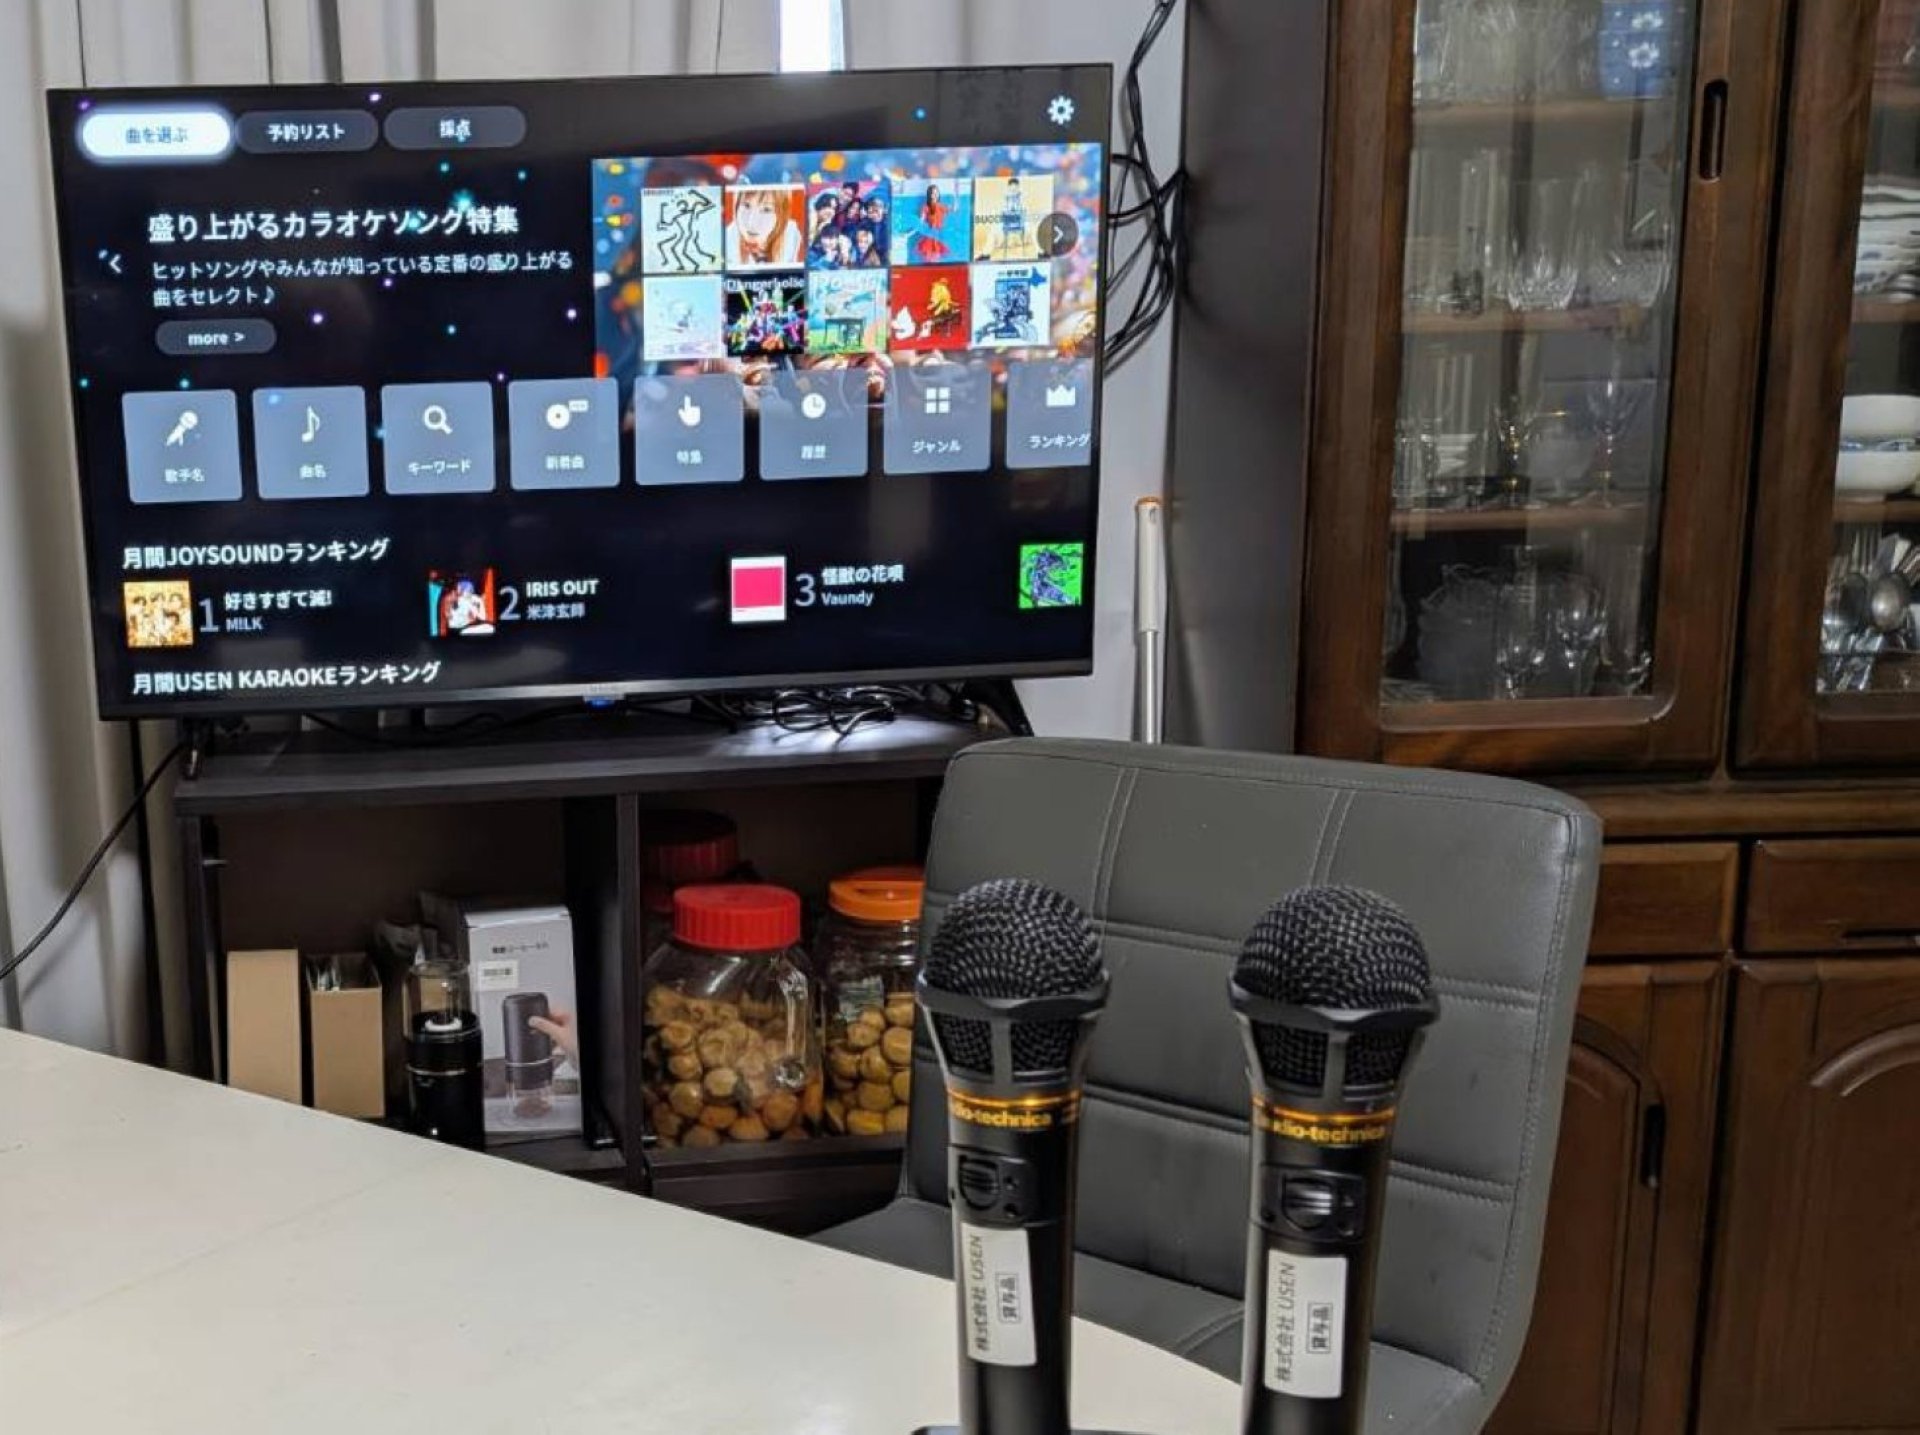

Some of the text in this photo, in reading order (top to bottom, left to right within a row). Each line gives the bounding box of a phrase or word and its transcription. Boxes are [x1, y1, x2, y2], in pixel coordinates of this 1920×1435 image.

[126, 125, 188, 144] 曲を選ぶ
[267, 122, 345, 142] 予約リスト
[149, 205, 519, 242] 盛り上がるカラオケソング特集
[153, 251, 573, 281] ヒットソングやみんなが知っている定番の盛り上がる
[188, 332, 228, 346] more
[912, 439, 961, 454] ジャンル
[1029, 433, 1091, 449] ランキング
[408, 458, 471, 475] キーワード
[122, 537, 390, 570] 月間JOYSOUNDランキング
[499, 585, 521, 621] 2
[526, 579, 599, 597] IRIS OUT
[795, 573, 816, 607] 3
[821, 591, 873, 607] Vaundy
[199, 599, 219, 633] 1
[133, 660, 441, 695] 月間USEN KARAOKEランキング
[970, 1234, 983, 1280] USEN
[1276, 1262, 1296, 1310] USEN
